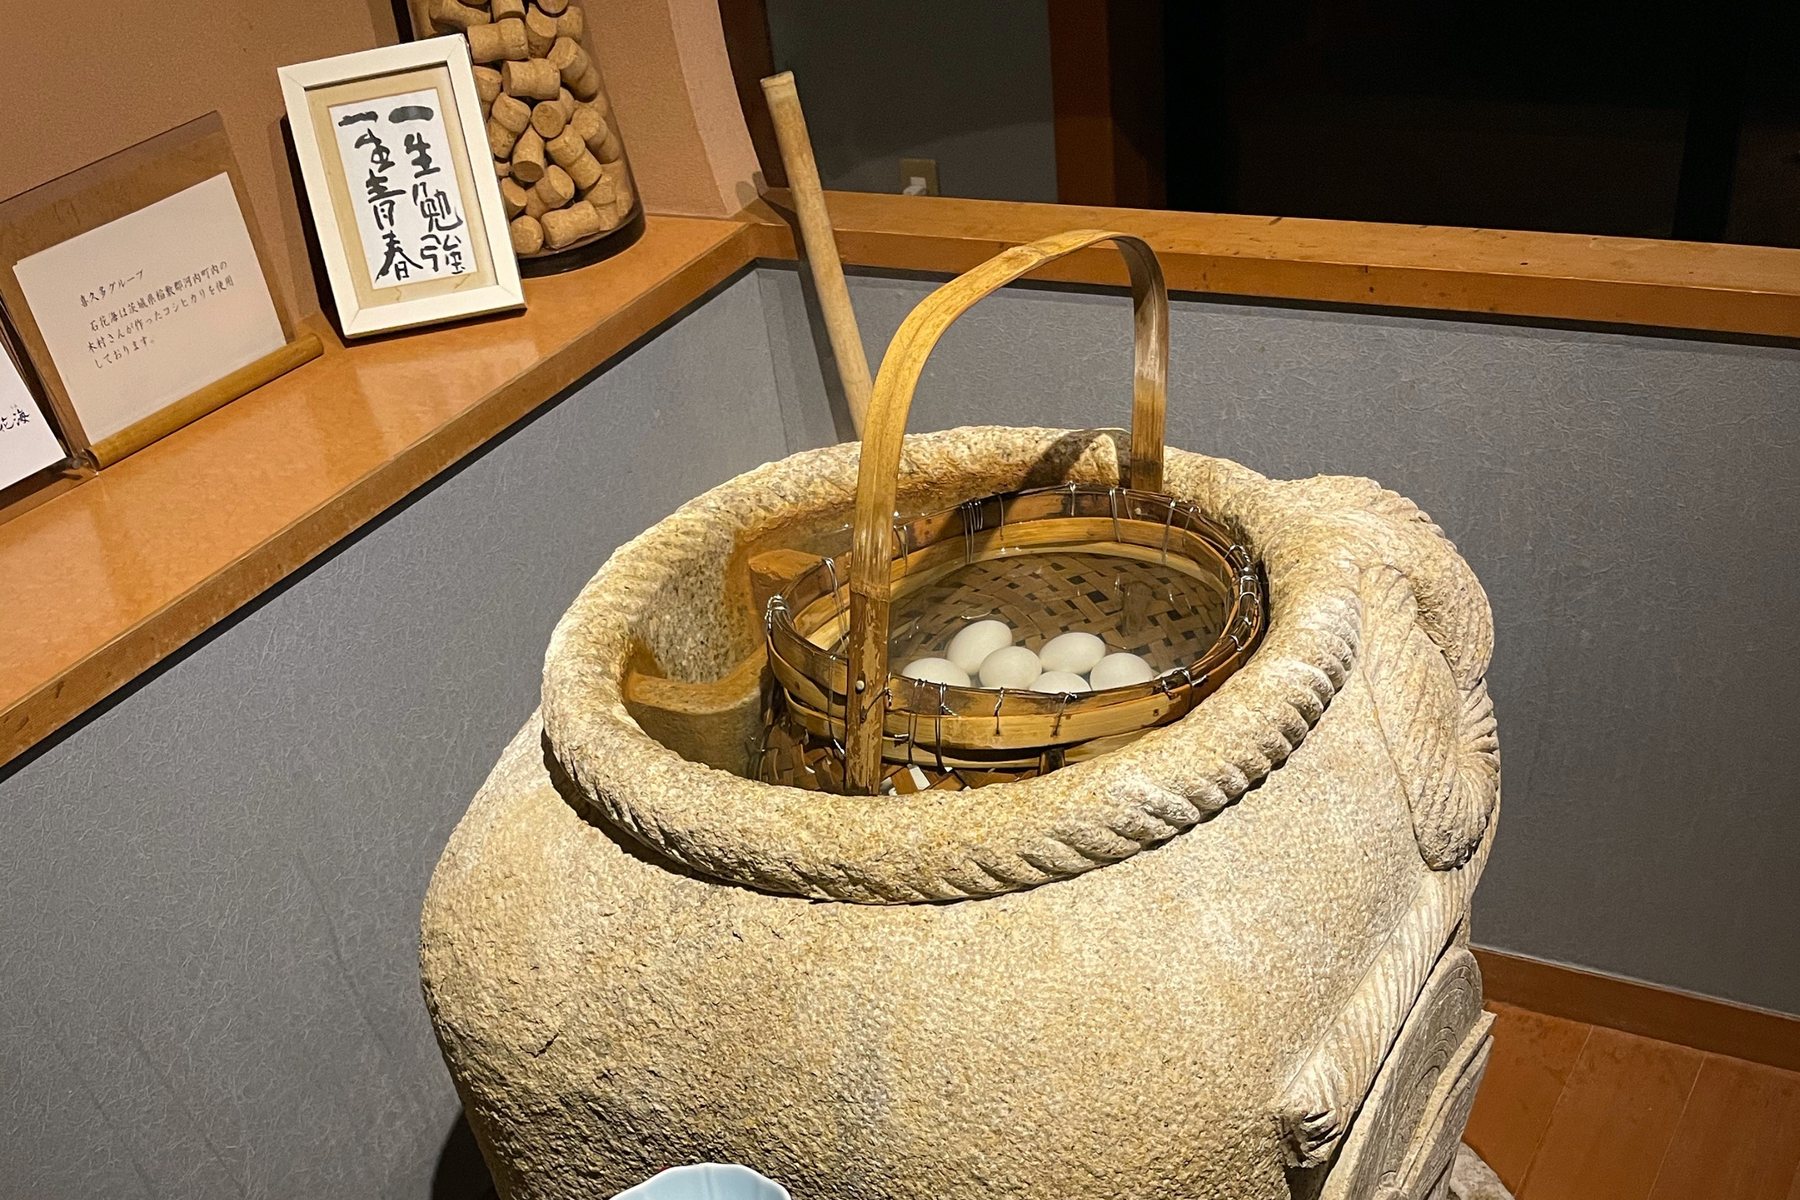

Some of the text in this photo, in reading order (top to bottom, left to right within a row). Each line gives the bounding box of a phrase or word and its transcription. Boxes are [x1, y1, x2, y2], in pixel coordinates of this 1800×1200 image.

[338, 110, 423, 284] 一生青春
[388, 105, 466, 275] 一生勉強
[88, 275, 235, 353] 木村さんが作ったコシヒカリを使用
[94, 335, 155, 369] しております。
